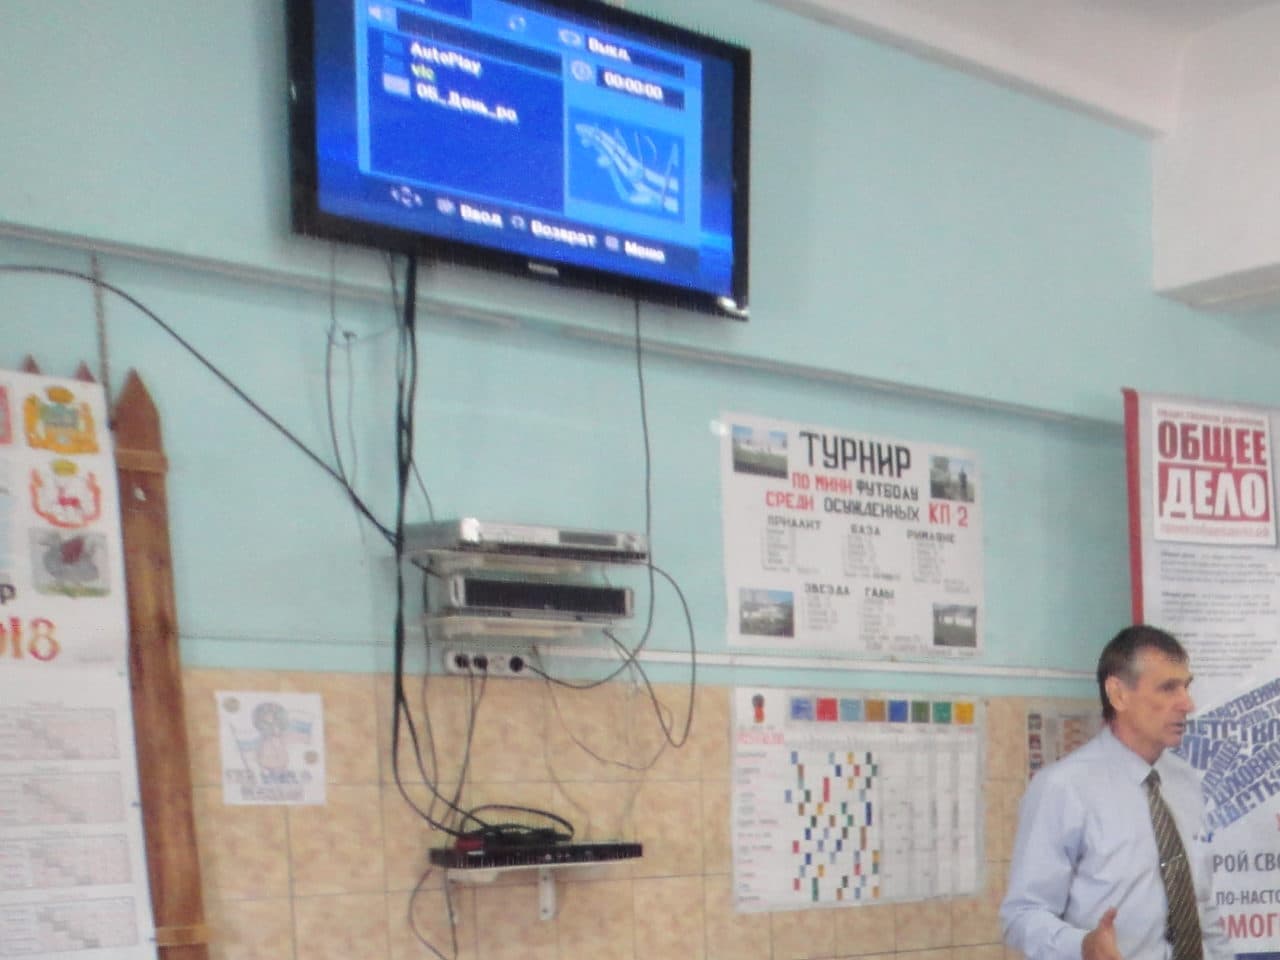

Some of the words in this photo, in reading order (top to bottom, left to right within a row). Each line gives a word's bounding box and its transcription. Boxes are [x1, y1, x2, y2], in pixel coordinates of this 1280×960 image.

[410, 42, 483, 78] AutoPlay
[604, 71, 664, 101] 00:00:00
[531, 220, 597, 248] Возврат
[799, 431, 911, 478] ТУРНИР
[1158, 420, 1267, 470] ОБЩЕЕ
[792, 472, 810, 490] ПО
[856, 479, 919, 501] ФУТБОЛУ
[1162, 467, 1267, 521] ДЕЛО
[928, 502, 951, 525] КП
[957, 506, 969, 528] 2
[1212, 850, 1249, 873] РОЙ
